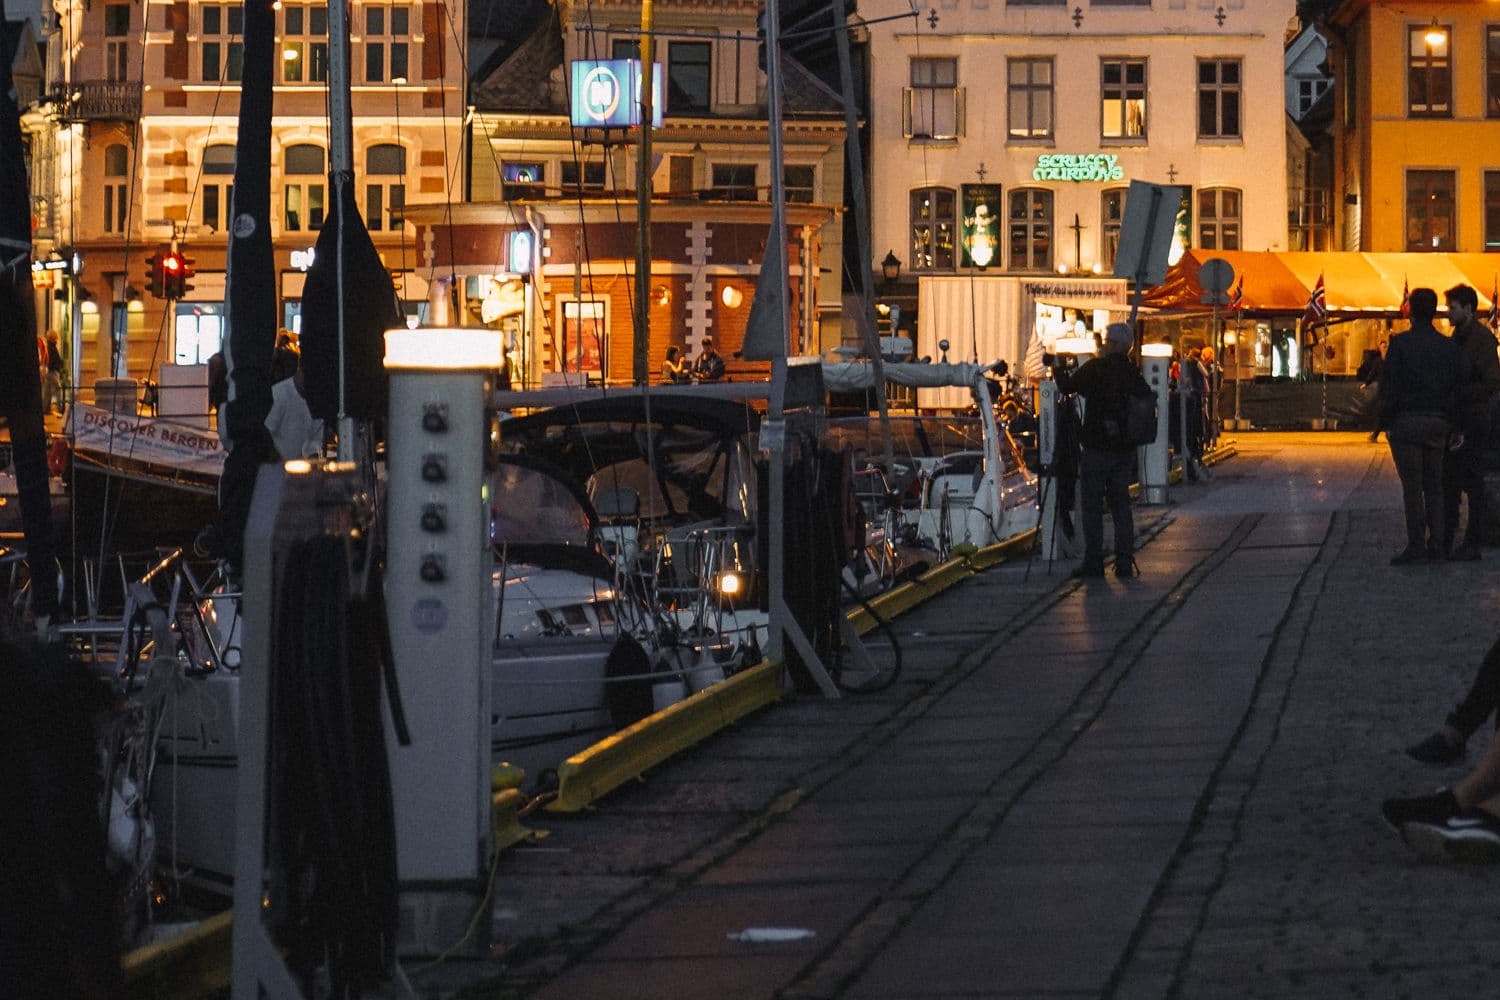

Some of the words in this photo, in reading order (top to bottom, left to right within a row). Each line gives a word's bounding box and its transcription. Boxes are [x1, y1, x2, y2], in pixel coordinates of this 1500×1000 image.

[1037, 154, 1118, 170] SCRUFFY
[83, 412, 156, 439] DISCOVER
[160, 428, 219, 451] BERGEN
